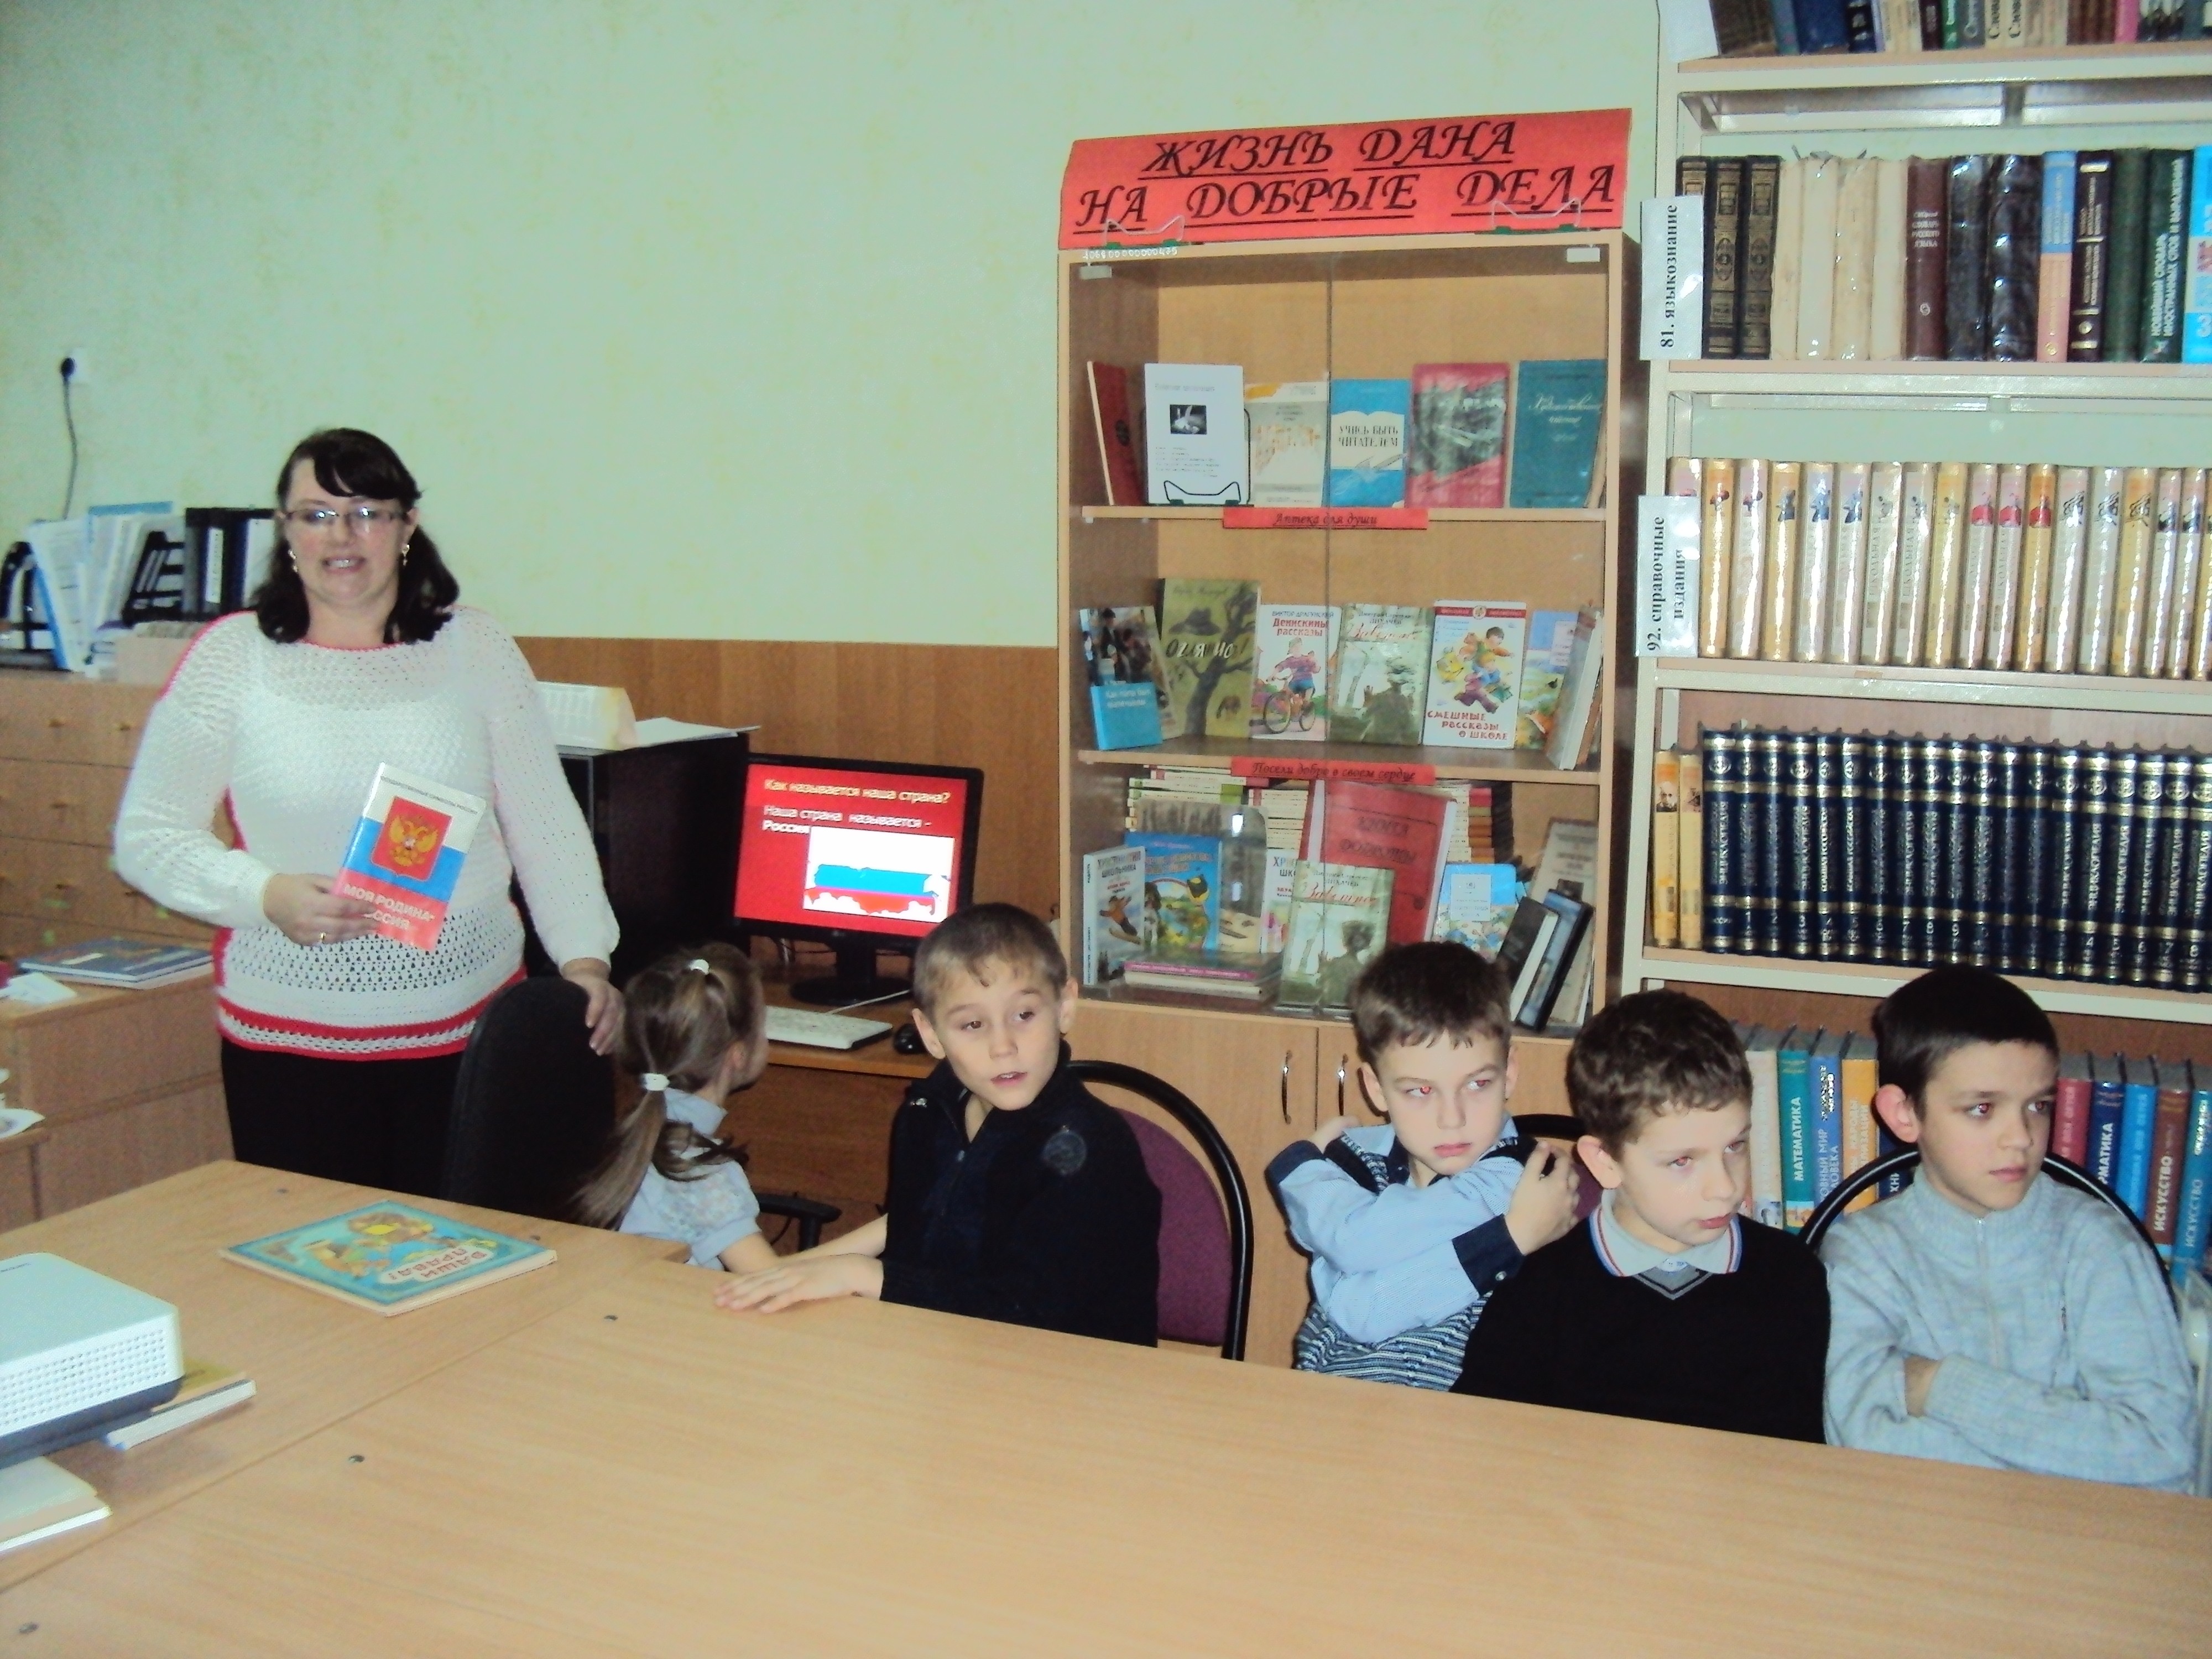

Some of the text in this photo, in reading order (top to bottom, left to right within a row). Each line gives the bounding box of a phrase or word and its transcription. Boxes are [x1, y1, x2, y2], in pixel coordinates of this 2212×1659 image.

[1142, 121, 1516, 177] ЖИЗНЬ ДАНА
[1076, 165, 1614, 226] НА ДОБРЫЕ ДЕЛА
[1660, 204, 1678, 348] 81. языкознание
[1339, 425, 1399, 435] УЧИСЬ БЫТЬ
[1339, 437, 1398, 447] ЧИТАТЕЛЕМ
[1274, 513, 1378, 525] Аптека для души
[1647, 516, 1665, 651] 92. справочные
[1673, 549, 1687, 620] издания
[1273, 618, 1329, 629] Денискины
[1427, 711, 1486, 721] СМЕШНЫЕ
[1469, 731, 1508, 740] ШКОЛЕ
[1253, 762, 1293, 774] Посели
[1296, 763, 1329, 777] добро
[1379, 768, 1416, 782] сердце
[764, 779, 951, 805] Как называется наша страна?
[764, 805, 798, 818] Наша
[800, 809, 843, 822] страна
[848, 813, 922, 829] называется
[363, 910, 410, 930] ССИЯ
[1799, 915, 1806, 927] 3
[1952, 923, 1959, 936] 9
[1790, 1096, 1802, 1182] МАТЕМАТИКА
[1818, 1128, 1828, 1153] МИР
[2097, 1122, 2114, 1185] РМАТИКА
[1817, 1157, 1829, 1201] ОВНЫЙ
[1828, 1145, 1839, 1190] ЛОВЕКА
[2153, 1156, 2173, 1232] ИСКУССТВО
[2185, 1178, 2204, 1248] ИСКУССТВО
